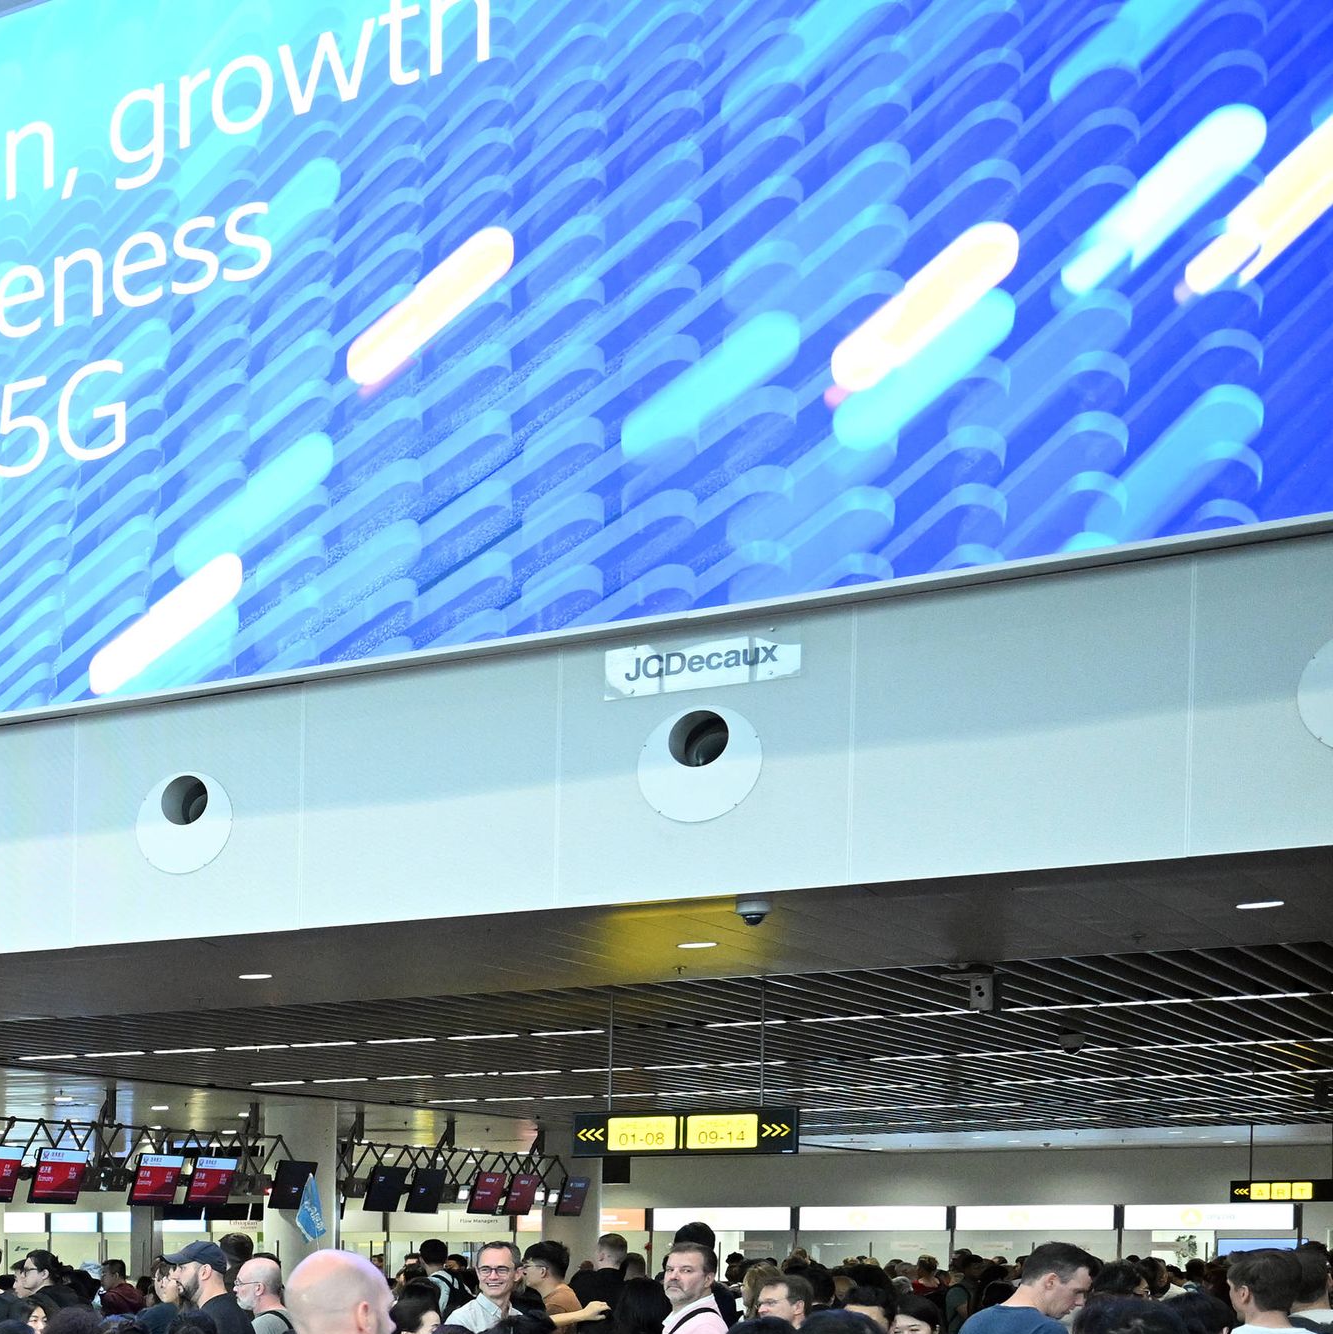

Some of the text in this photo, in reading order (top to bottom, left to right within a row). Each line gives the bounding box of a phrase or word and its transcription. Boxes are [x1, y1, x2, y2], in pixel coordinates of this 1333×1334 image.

[109, 0, 491, 193] growth
[625, 643, 778, 683] JCDecaux
[619, 1132, 664, 1146] 01-08
[698, 1130, 745, 1145] 09-14
